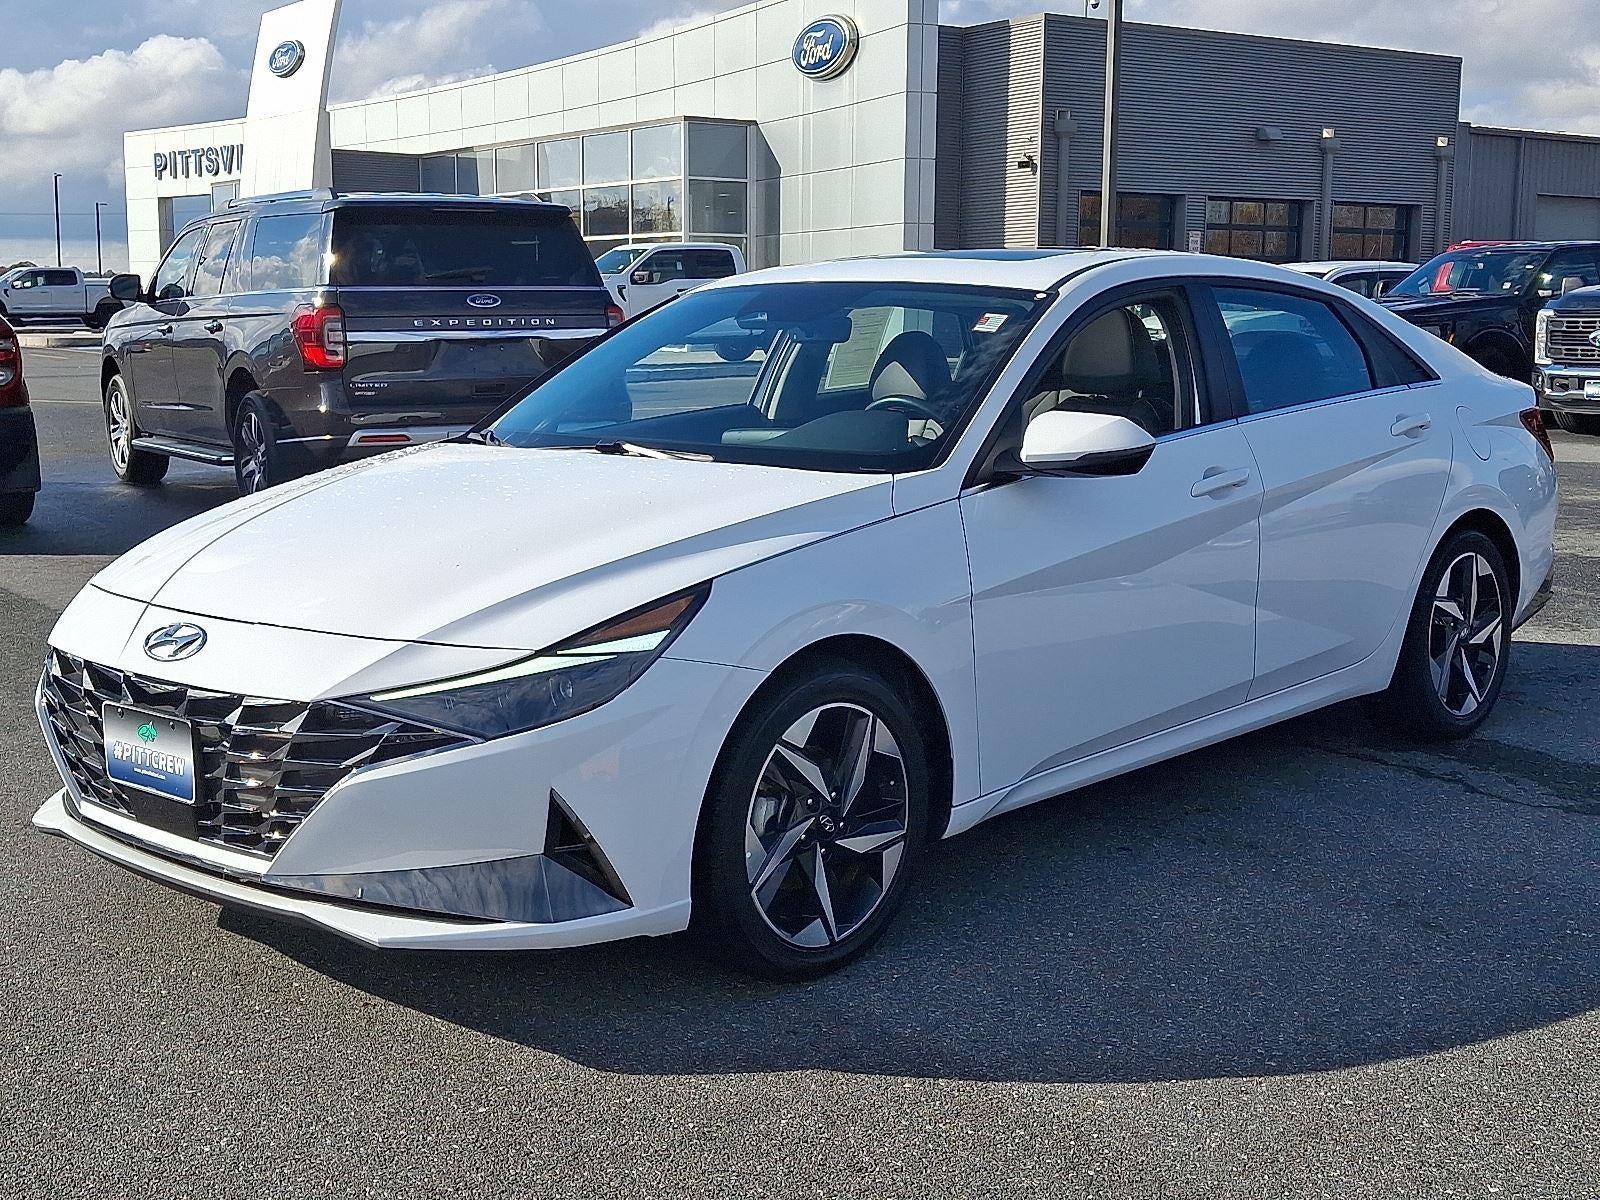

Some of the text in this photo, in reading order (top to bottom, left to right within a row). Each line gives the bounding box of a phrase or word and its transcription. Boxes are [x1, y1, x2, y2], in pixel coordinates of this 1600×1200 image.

[271, 47, 292, 69] Ford
[801, 29, 834, 68] Ford
[413, 318, 556, 326] EXPEDITION
[113, 740, 186, 776] #PITTCREW
